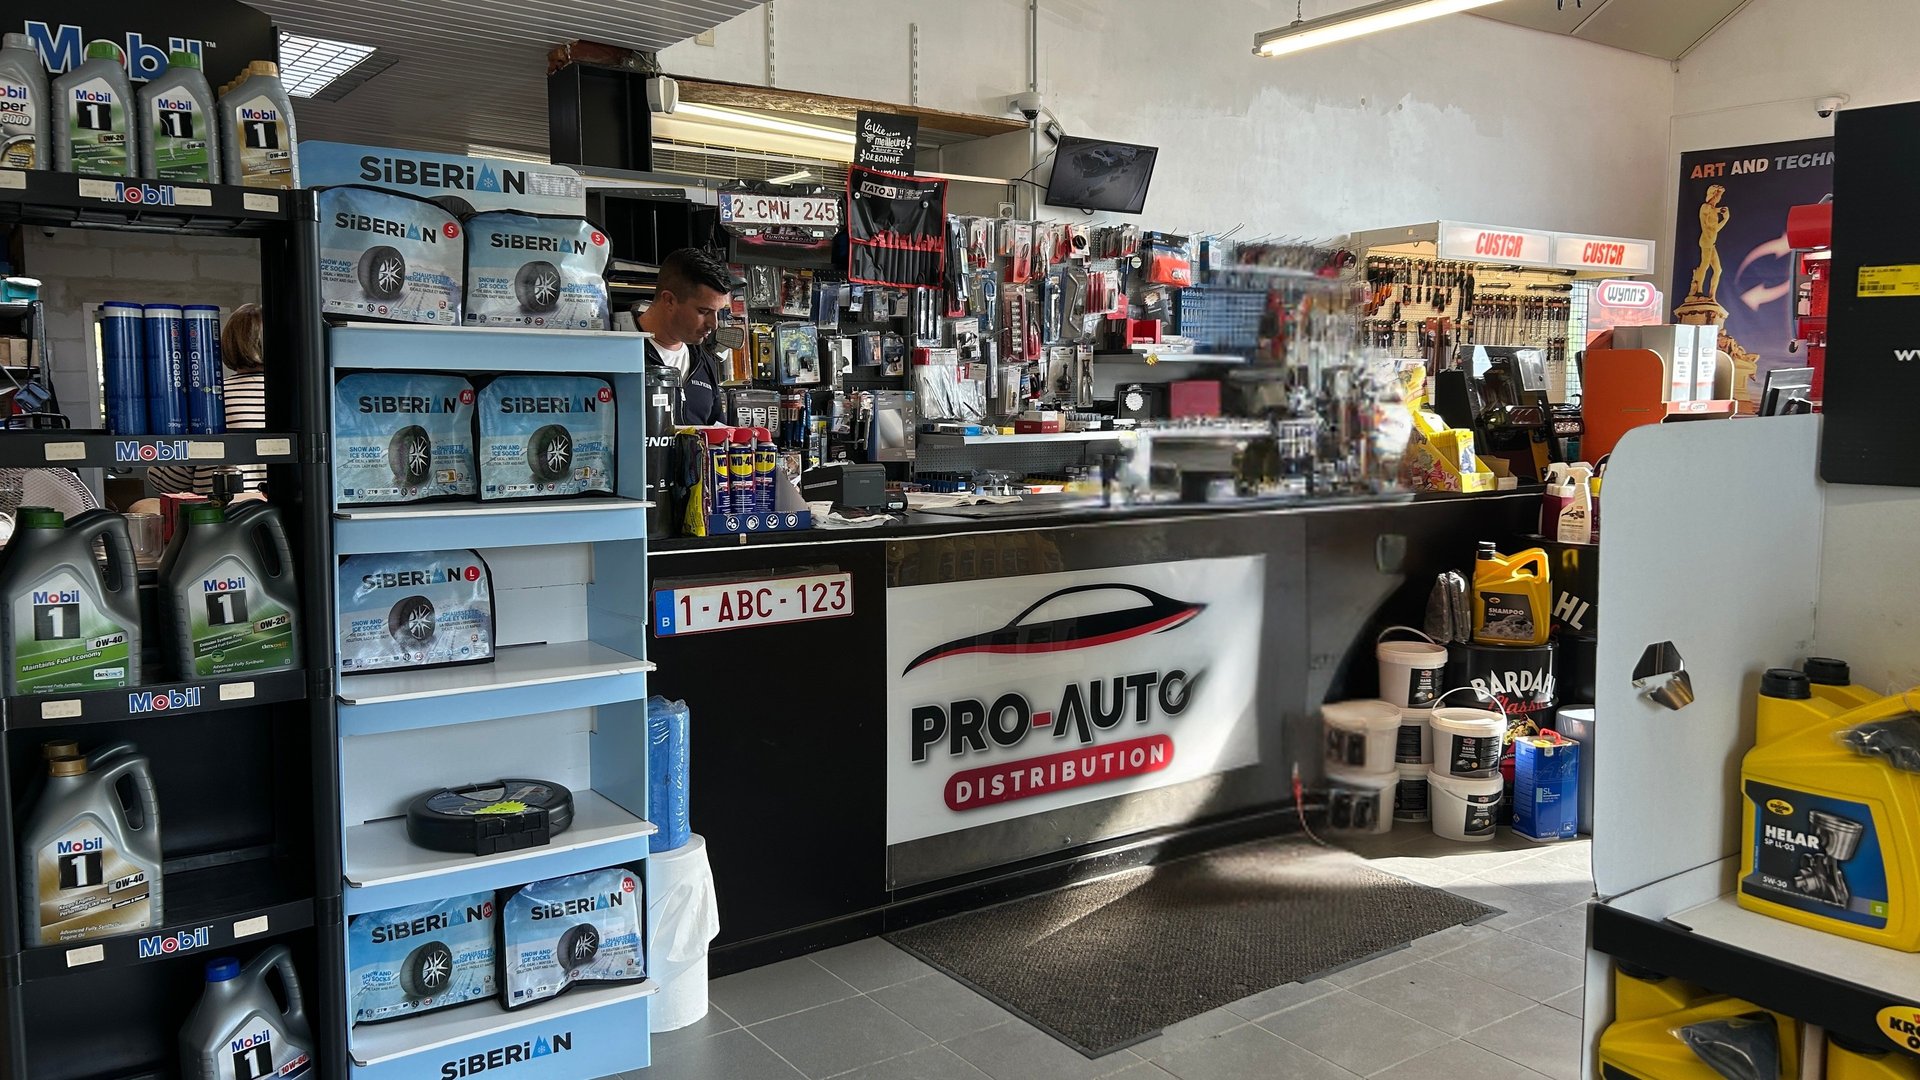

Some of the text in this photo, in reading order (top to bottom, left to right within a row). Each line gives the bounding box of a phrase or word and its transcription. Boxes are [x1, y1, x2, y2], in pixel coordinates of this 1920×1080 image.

[24, 20, 203, 82] Mbl
[0, 86, 27, 99] obil
[76, 89, 111, 103] Mobil
[0, 101, 26, 112] per
[158, 99, 192, 110] Mobil
[2, 114, 31, 126] 3000
[87, 104, 100, 129] 1
[242, 108, 276, 120] Mobil
[169, 113, 182, 137] 1
[253, 122, 267, 148] 1
[874, 137, 906, 147] meilleure
[1690, 162, 1726, 179] ART
[1731, 158, 1769, 175] AND
[863, 183, 886, 195] YATO
[447, 225, 454, 235] S
[594, 232, 602, 242] S
[1476, 232, 1524, 258] CUSTOR
[1582, 242, 1625, 266] CUSTOR
[173, 351, 181, 388] Grease
[191, 351, 200, 388] Grease
[463, 392, 472, 401] M
[600, 390, 609, 400] M
[116, 441, 189, 462] Mobil
[204, 577, 246, 592] Mobil
[33, 590, 80, 604] Mobil
[217, 594, 235, 624] 1
[1488, 607, 1525, 616] SHAMPOO
[47, 606, 65, 638] 1
[260, 616, 286, 630] 0W-20
[662, 617, 671, 627] B
[95, 635, 123, 648] 0W-40
[22, 651, 102, 672] Maintains Fuel Economy
[128, 687, 201, 713] Mobil
[911, 669, 1195, 763] PRO-AUTO
[956, 743, 1165, 804] DISTRIBUTION
[1765, 824, 1820, 849] HELAR
[1775, 839, 1795, 851] LL-03
[57, 837, 103, 854] Mobil
[70, 855, 88, 887] 1
[115, 873, 144, 889] 0W-40
[1763, 875, 1788, 888] 5W-30
[139, 926, 209, 958] Mobil
[231, 1029, 270, 1052] Mobil
[244, 1048, 260, 1079] 1
